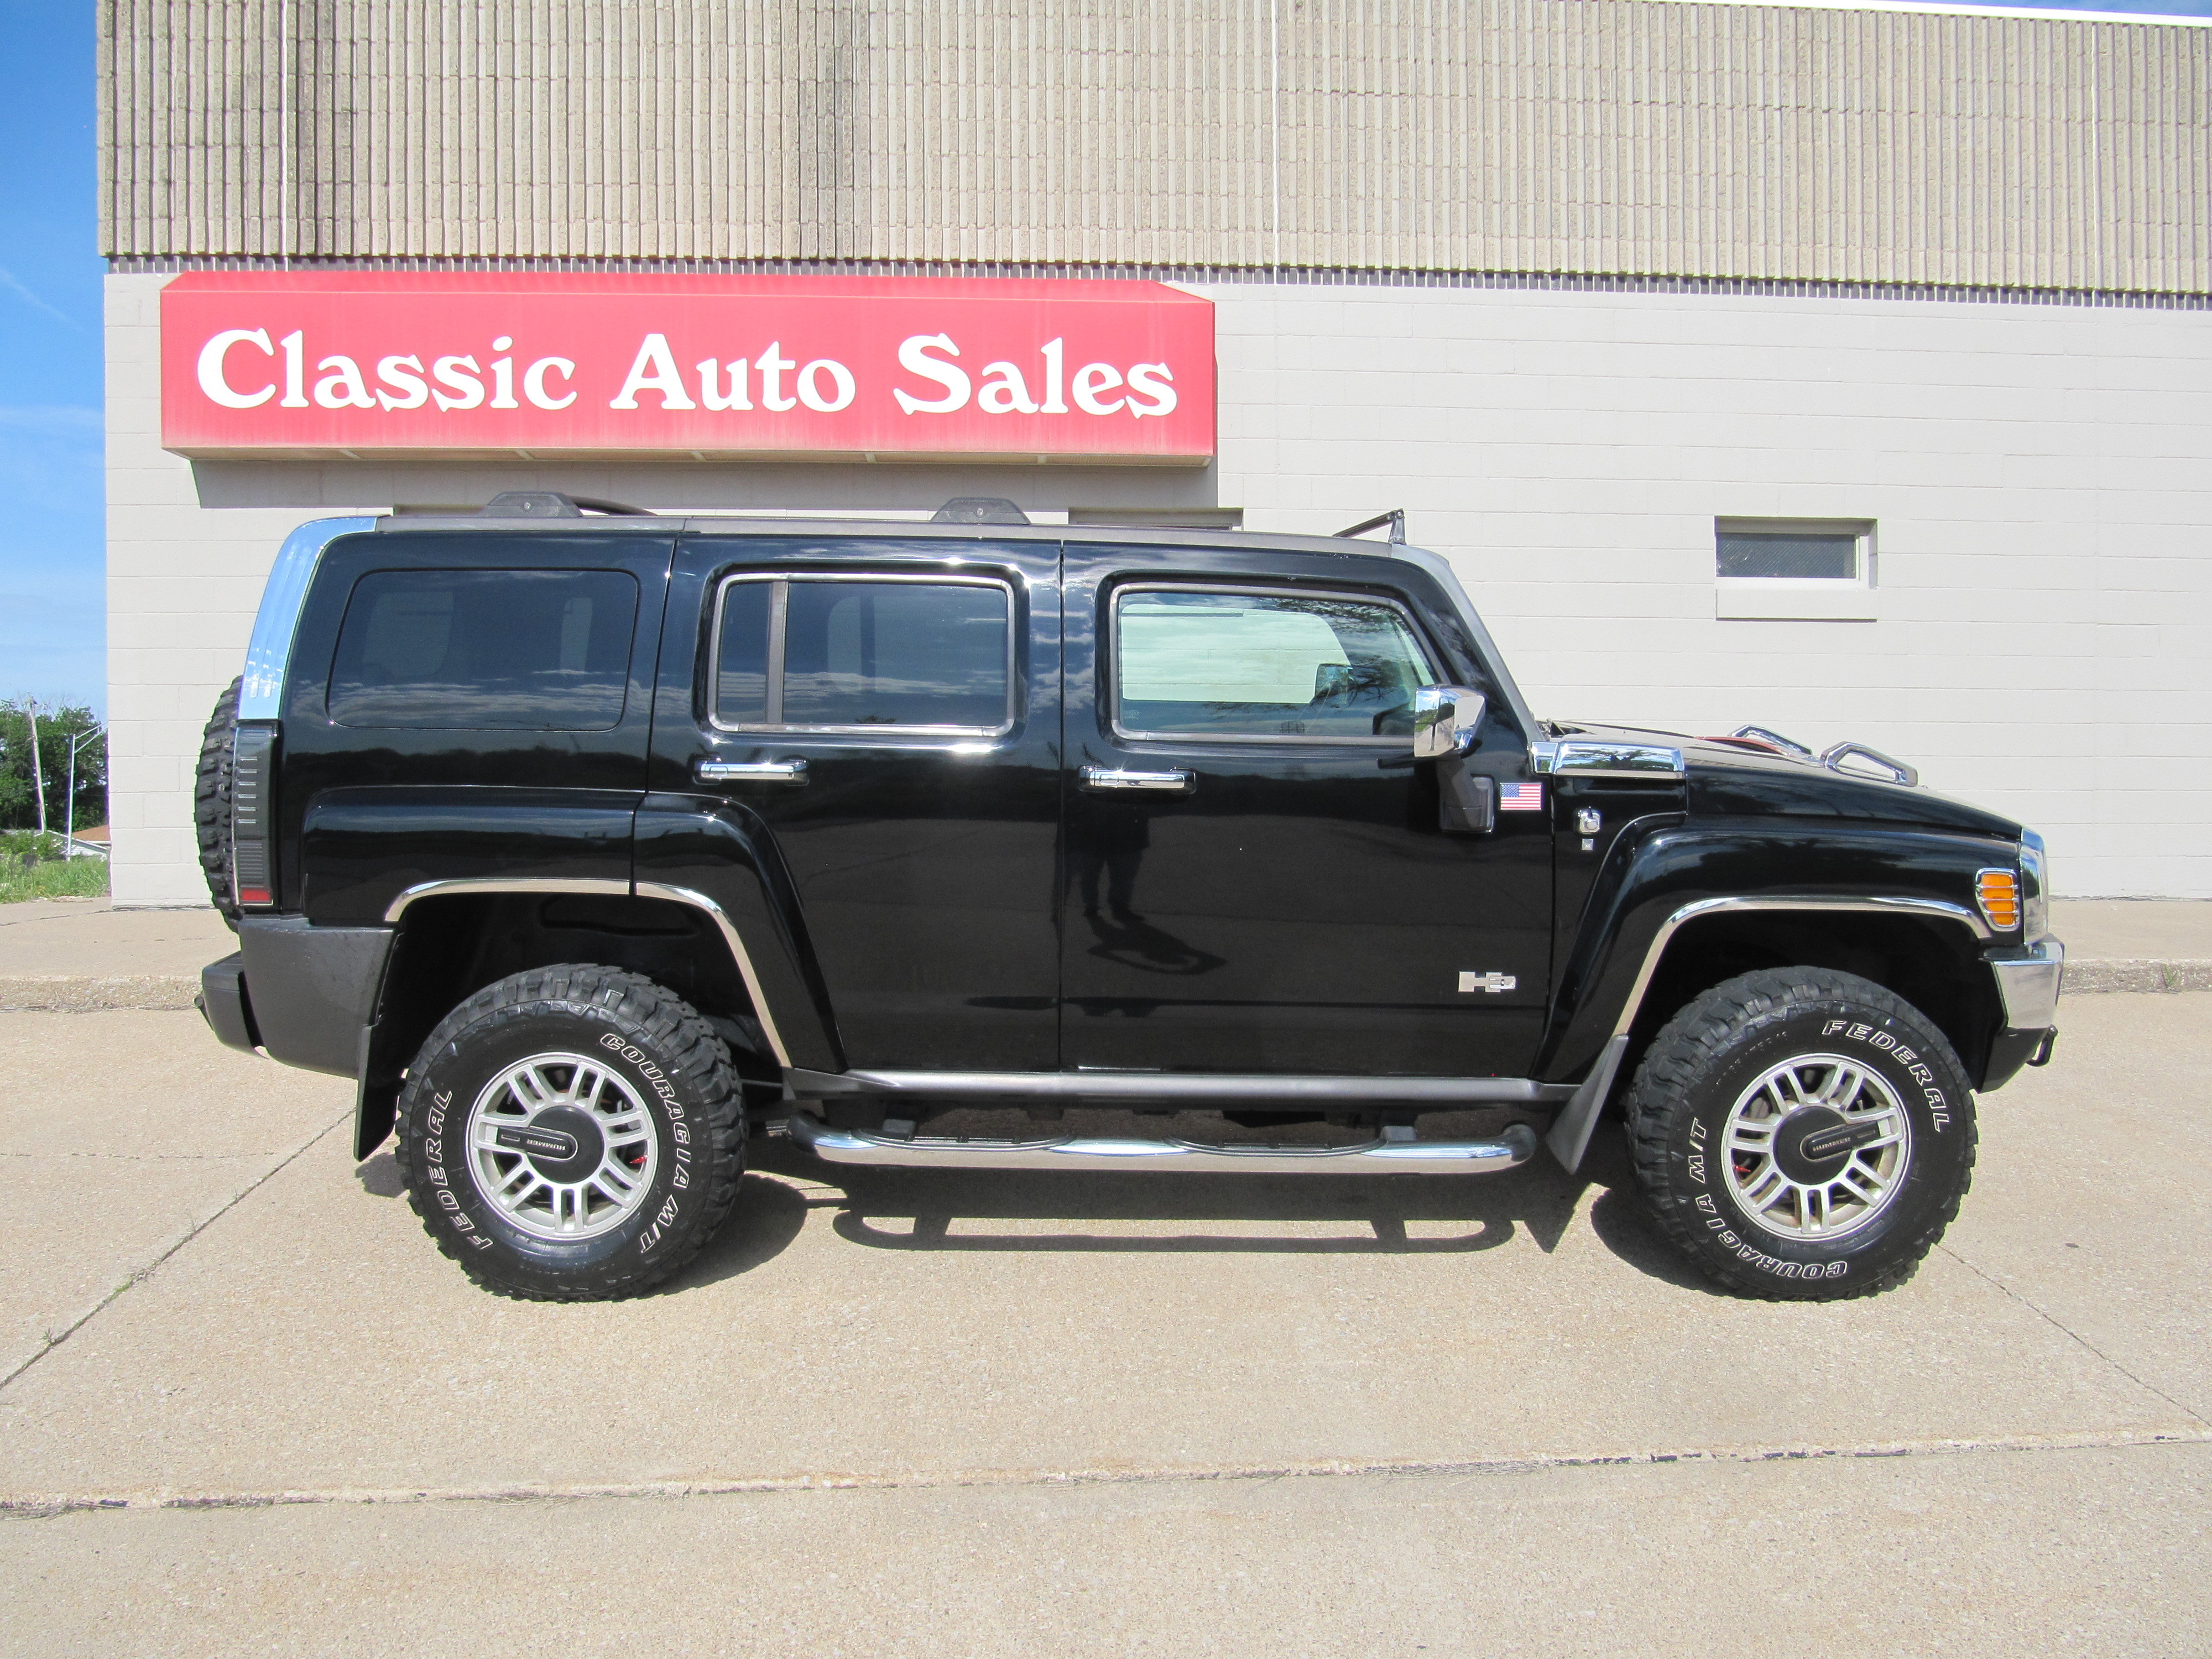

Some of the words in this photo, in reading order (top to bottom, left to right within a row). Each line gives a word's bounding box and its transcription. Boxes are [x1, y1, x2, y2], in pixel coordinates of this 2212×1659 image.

[197, 327, 578, 413] Classic
[609, 333, 856, 413] Auto
[893, 332, 1178, 420] Sales
[599, 1032, 691, 1188] COURAGIA
[1821, 1019, 1950, 1133] FEDERAL
[425, 1089, 494, 1251] FEDERAL
[526, 1139, 566, 1151] HUMMER
[1688, 1118, 1708, 1185] M/T
[1812, 1136, 1851, 1152] HUMMER
[640, 1193, 679, 1253] M/T
[1695, 1193, 1849, 1279] COURAGIA
